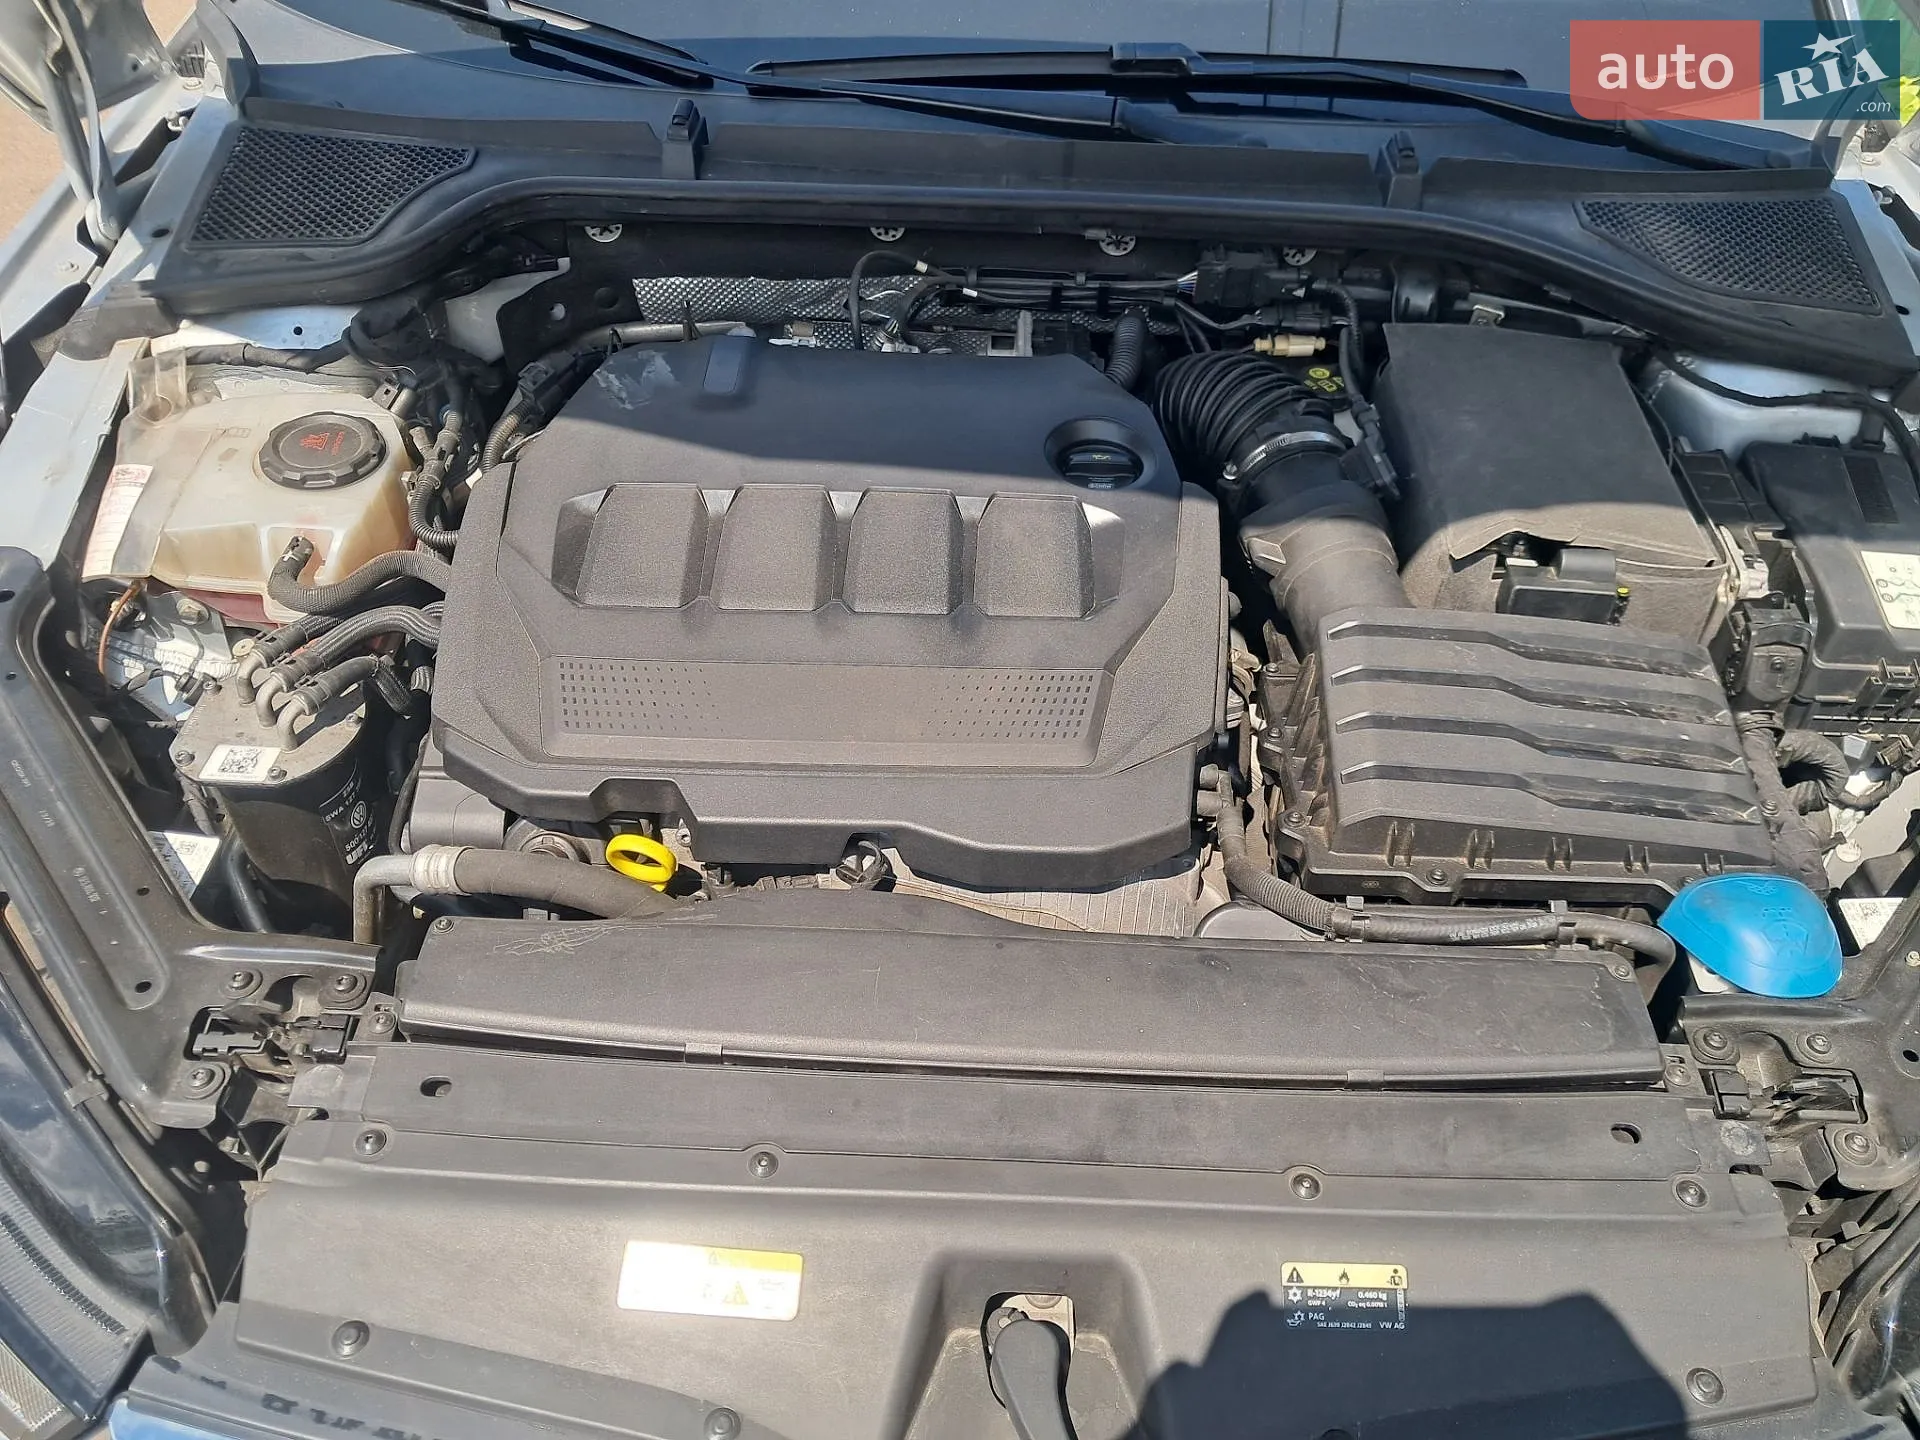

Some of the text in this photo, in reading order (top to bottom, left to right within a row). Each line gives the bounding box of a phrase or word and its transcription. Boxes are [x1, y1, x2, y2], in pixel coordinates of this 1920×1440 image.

[1307, 1288, 1340, 1301] R-1234yf
[1379, 1290, 1387, 1301] kg
[1308, 1312, 1325, 1321] PAG
[1379, 1321, 1405, 1330] VW AG
